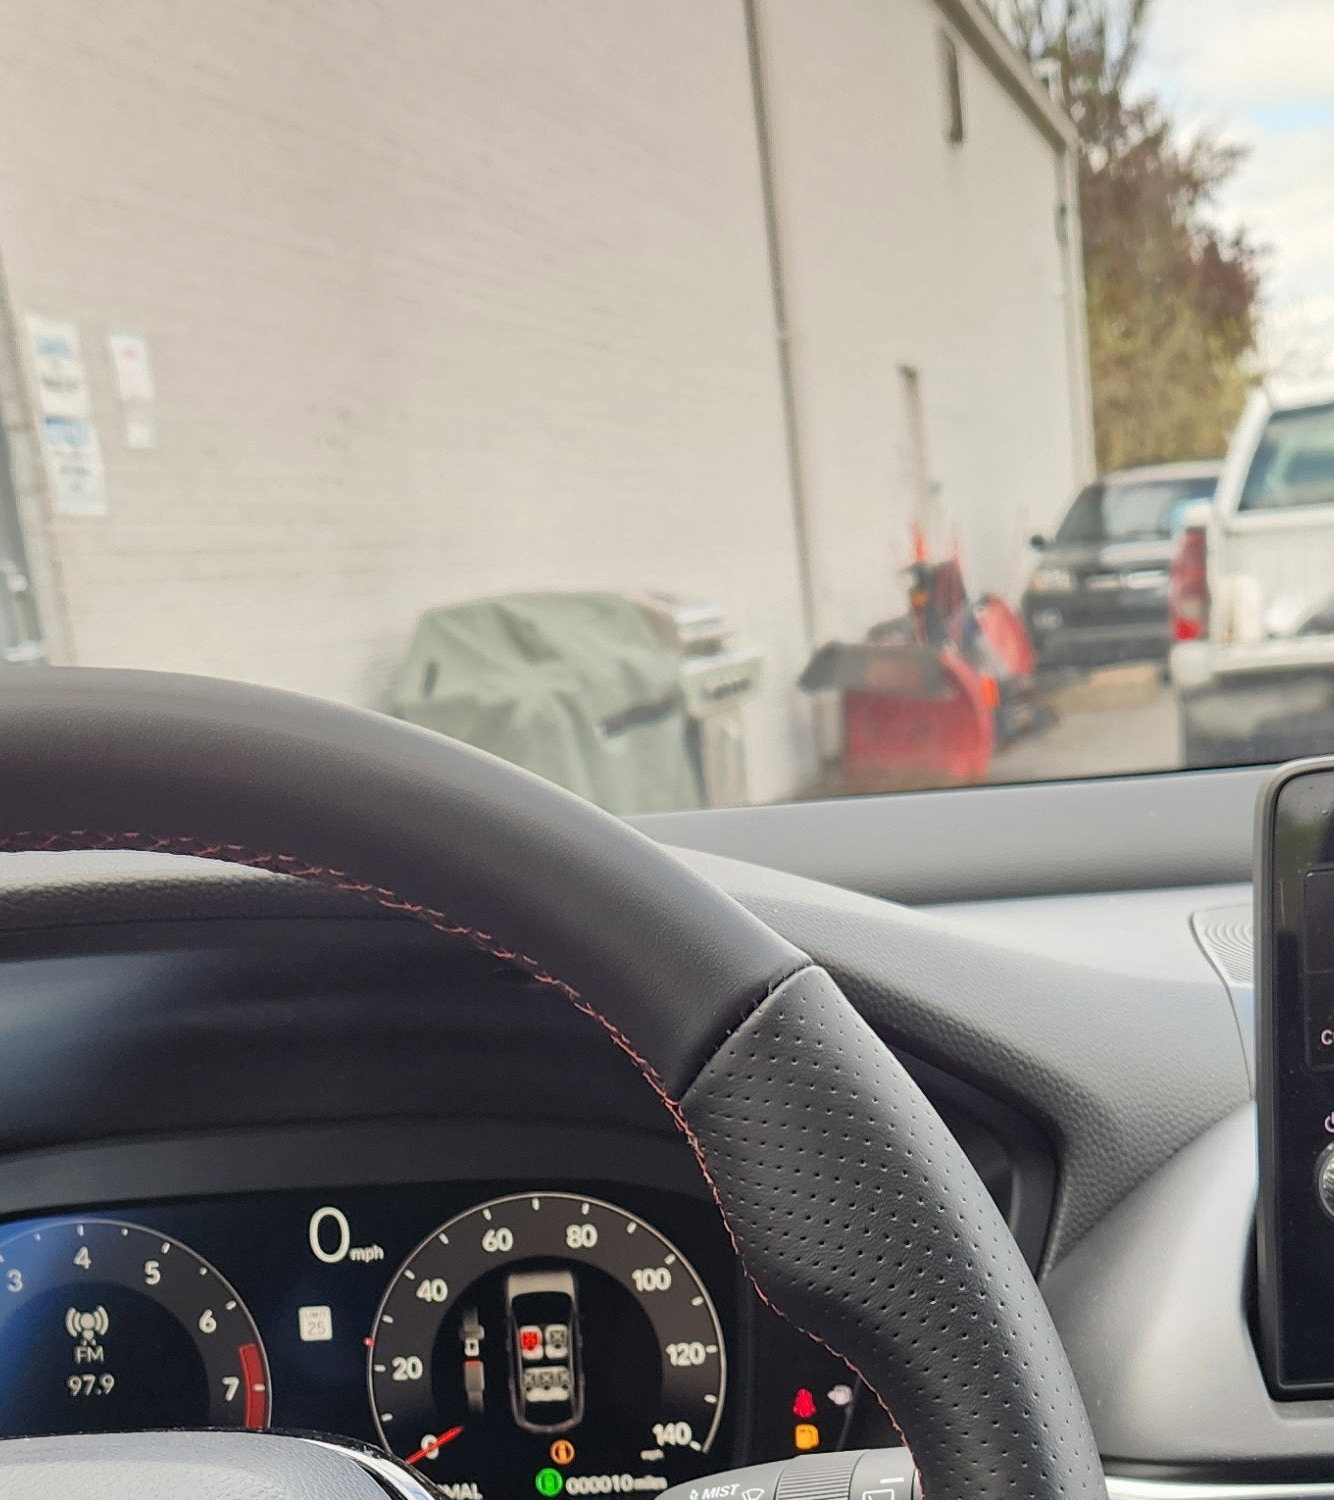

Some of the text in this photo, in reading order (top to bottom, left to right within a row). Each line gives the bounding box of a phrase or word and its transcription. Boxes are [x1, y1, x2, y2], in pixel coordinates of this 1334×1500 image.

[309, 1206, 385, 1264] 0 mph
[482, 1227, 514, 1253] 60
[566, 1223, 598, 1249] 80
[73, 1246, 92, 1270] 4
[6, 1269, 23, 1293] 3
[145, 1260, 161, 1286] 5
[631, 1267, 672, 1292] 100
[416, 1278, 448, 1302] 40
[199, 1309, 217, 1334] 6
[307, 1321, 327, 1336] 25
[75, 1345, 105, 1364] FM
[665, 1341, 705, 1367] 120
[392, 1355, 423, 1381] 20
[68, 1374, 115, 1397] 97.9
[222, 1376, 240, 1402] 7
[652, 1422, 690, 1447] 140
[565, 1474, 634, 1495] 000010
[701, 1484, 740, 1500] MIST
